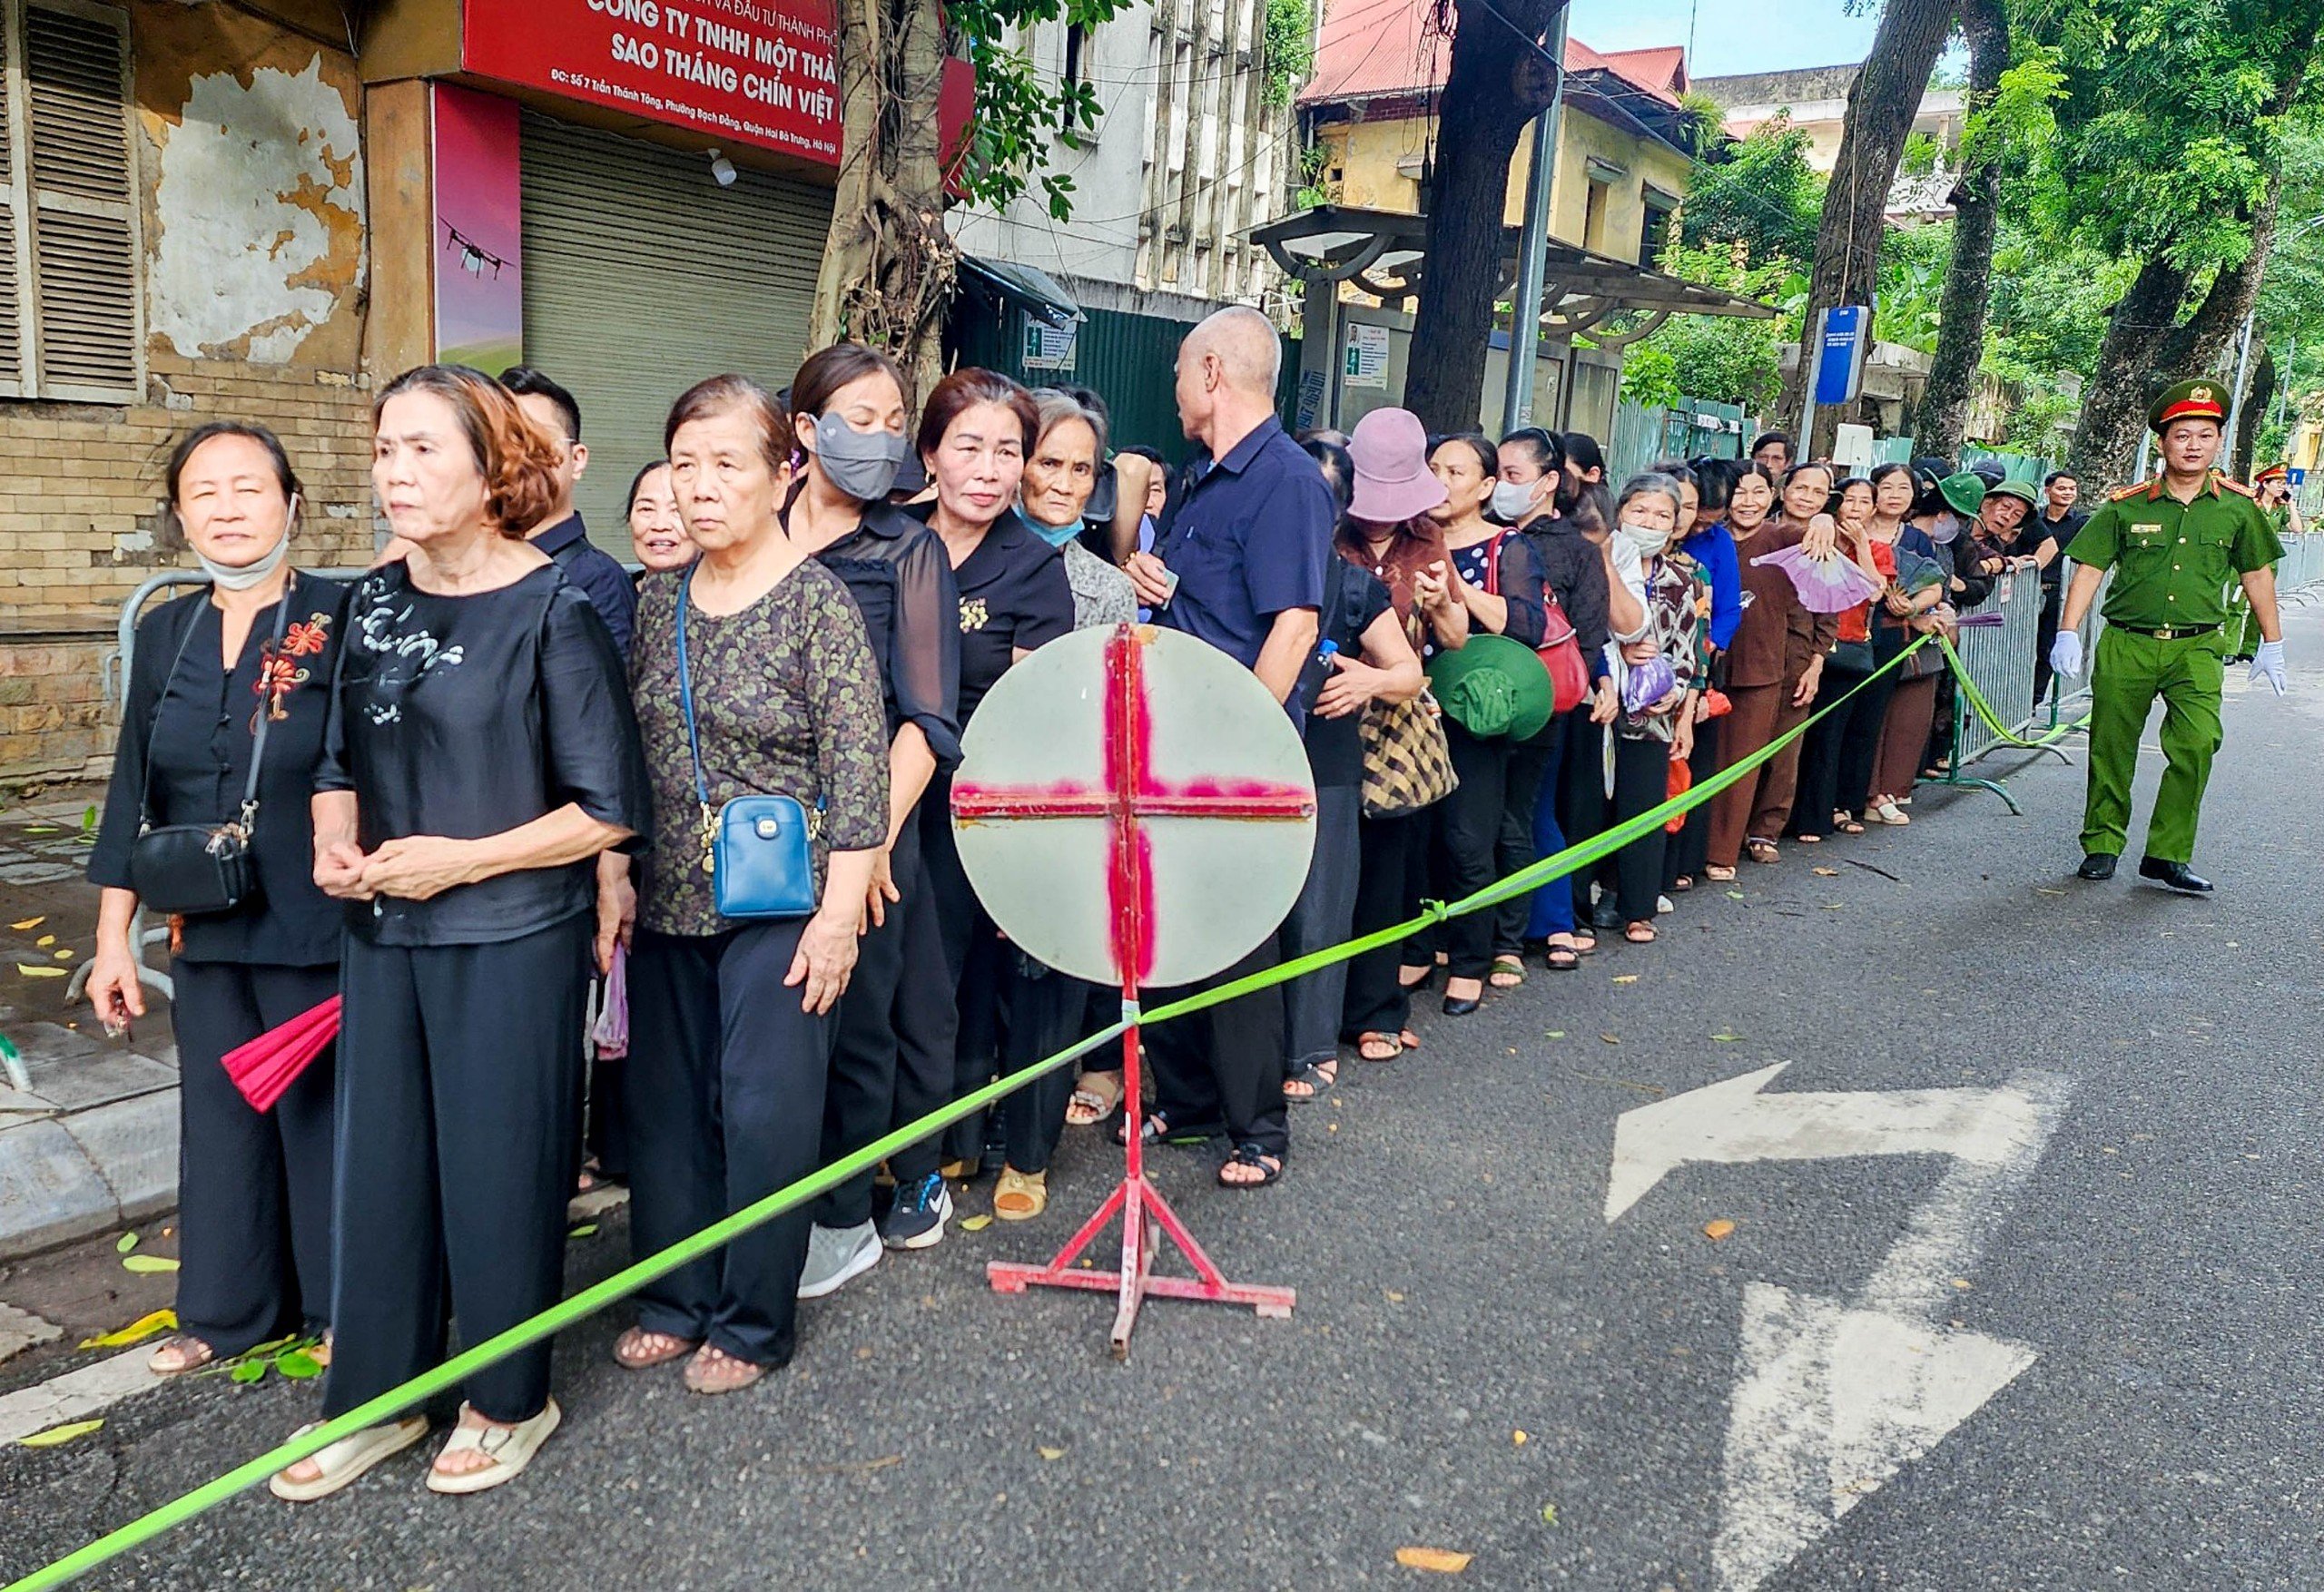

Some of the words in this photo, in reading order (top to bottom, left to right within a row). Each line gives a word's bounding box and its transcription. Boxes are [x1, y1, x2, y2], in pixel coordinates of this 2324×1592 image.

[665, 6, 690, 38] TY
[695, 16, 750, 58] TNHH
[755, 37, 797, 75] MỘT
[802, 52, 837, 84] THÀ
[763, 9, 776, 26] TƯ
[778, 14, 814, 41] THÀNH
[551, 68, 569, 83] ĐC:
[570, 74, 584, 87] Số
[584, 77, 591, 89] 7
[592, 78, 611, 94] Trần
[613, 84, 639, 102] Thánh
[665, 99, 695, 119] Phường
[697, 107, 717, 123] Bạch
[743, 121, 764, 136] Quận
[765, 126, 778, 140] Hai
[779, 130, 790, 142] Bà
[812, 138, 822, 151] Hà
[823, 141, 836, 155] Nội
[612, 33, 659, 69] SAO
[665, 48, 738, 93] THÁNG
[743, 74, 793, 110] CHÍN
[797, 87, 834, 125] VIỆT
